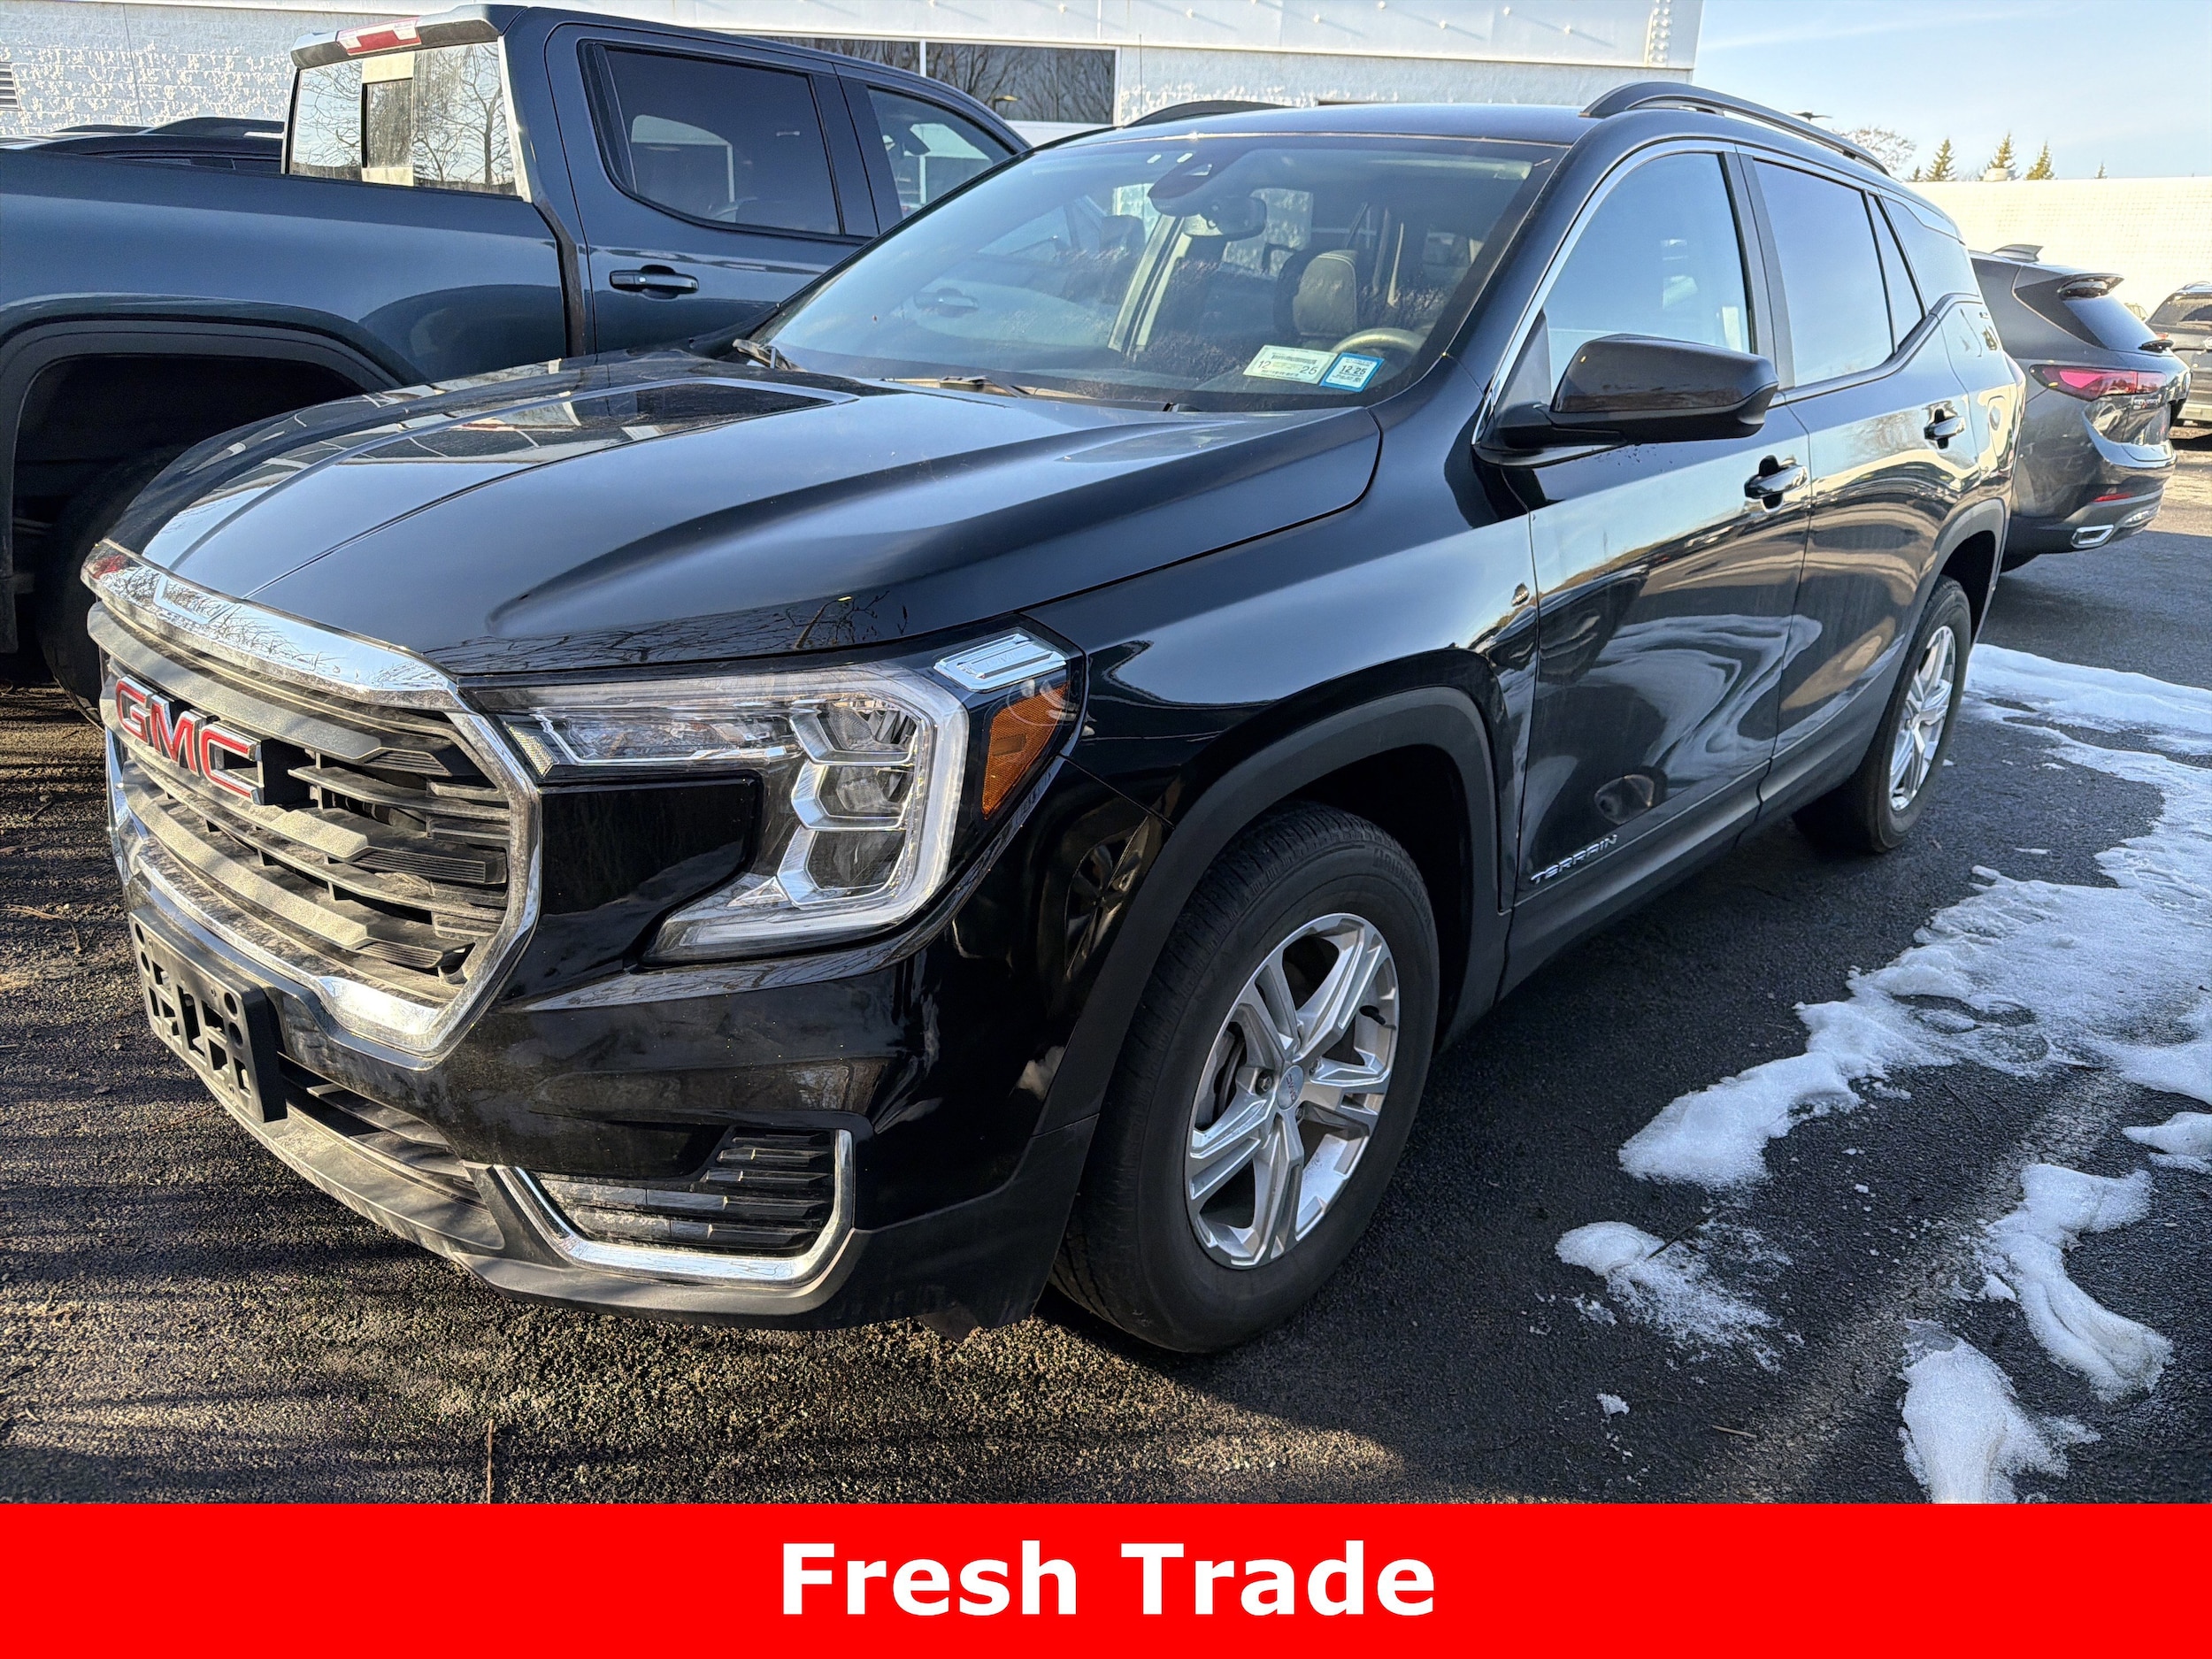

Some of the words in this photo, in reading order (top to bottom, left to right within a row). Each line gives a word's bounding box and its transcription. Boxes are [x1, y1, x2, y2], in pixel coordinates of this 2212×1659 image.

[1257, 360, 1271, 370] 12
[1300, 365, 1317, 375] 25
[115, 675, 264, 805] GMC
[1530, 834, 1617, 884] TERRAIN
